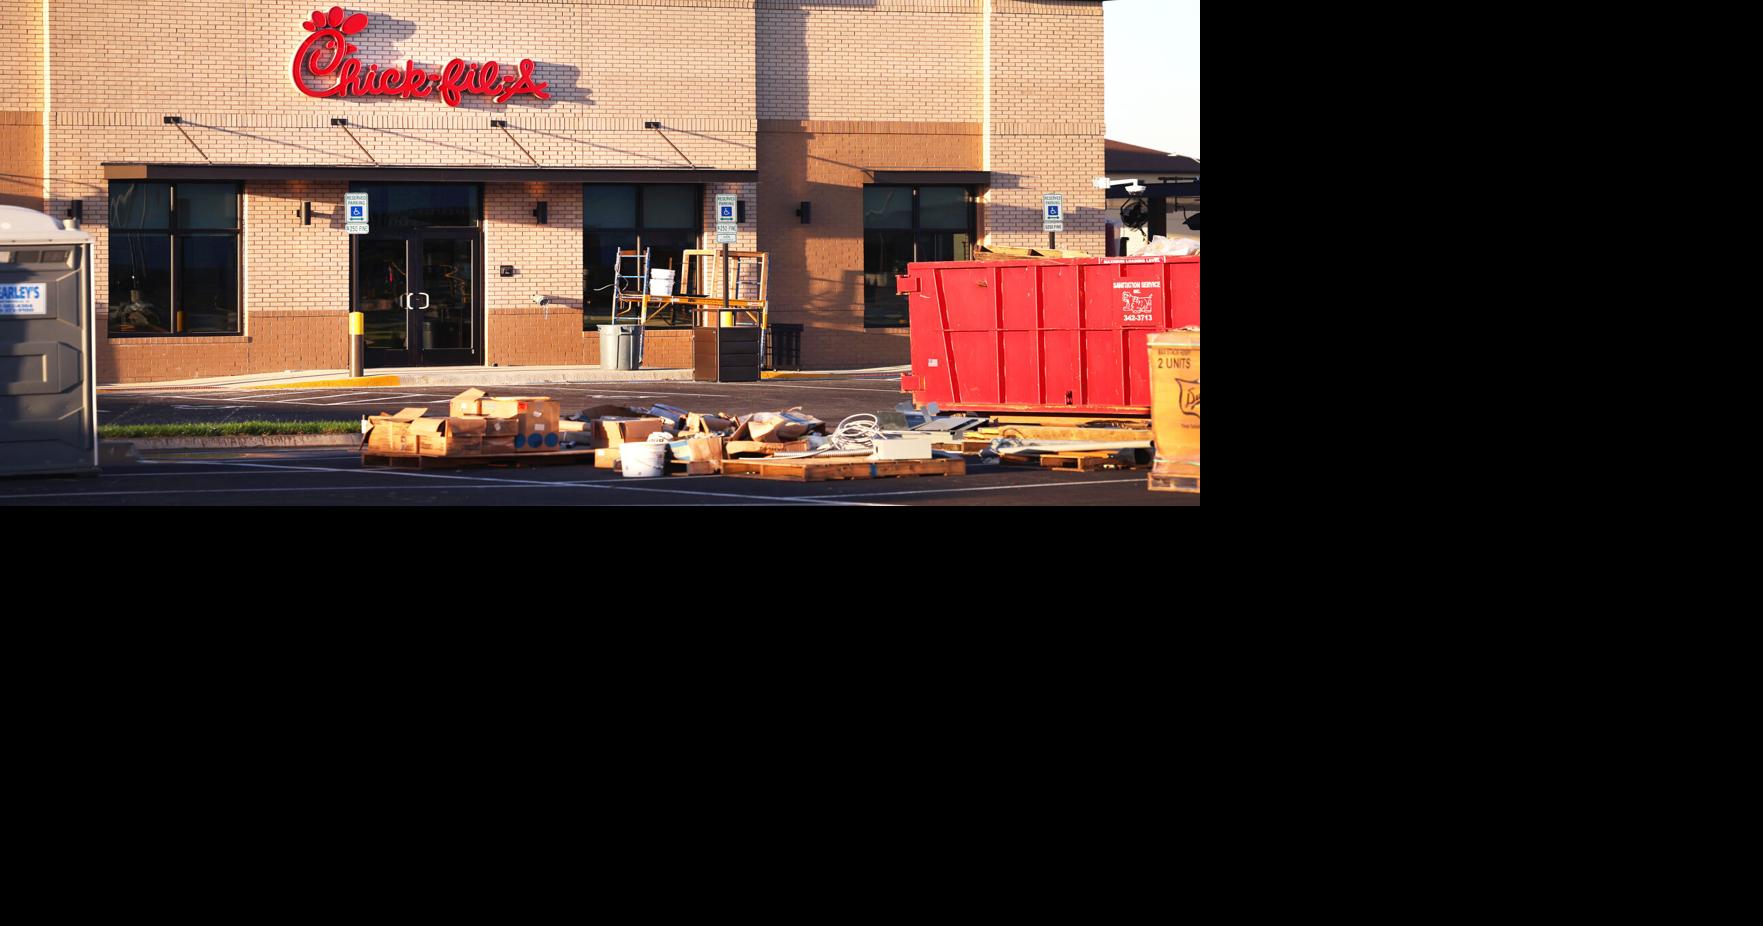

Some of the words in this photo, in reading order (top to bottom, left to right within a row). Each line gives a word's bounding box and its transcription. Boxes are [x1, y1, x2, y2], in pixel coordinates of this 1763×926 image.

[292, 6, 550, 107] Chick-fil-A
[1113, 281, 1140, 289] SANITATION
[1158, 358, 1164, 369] 2
[1166, 357, 1191, 369] UNITS
